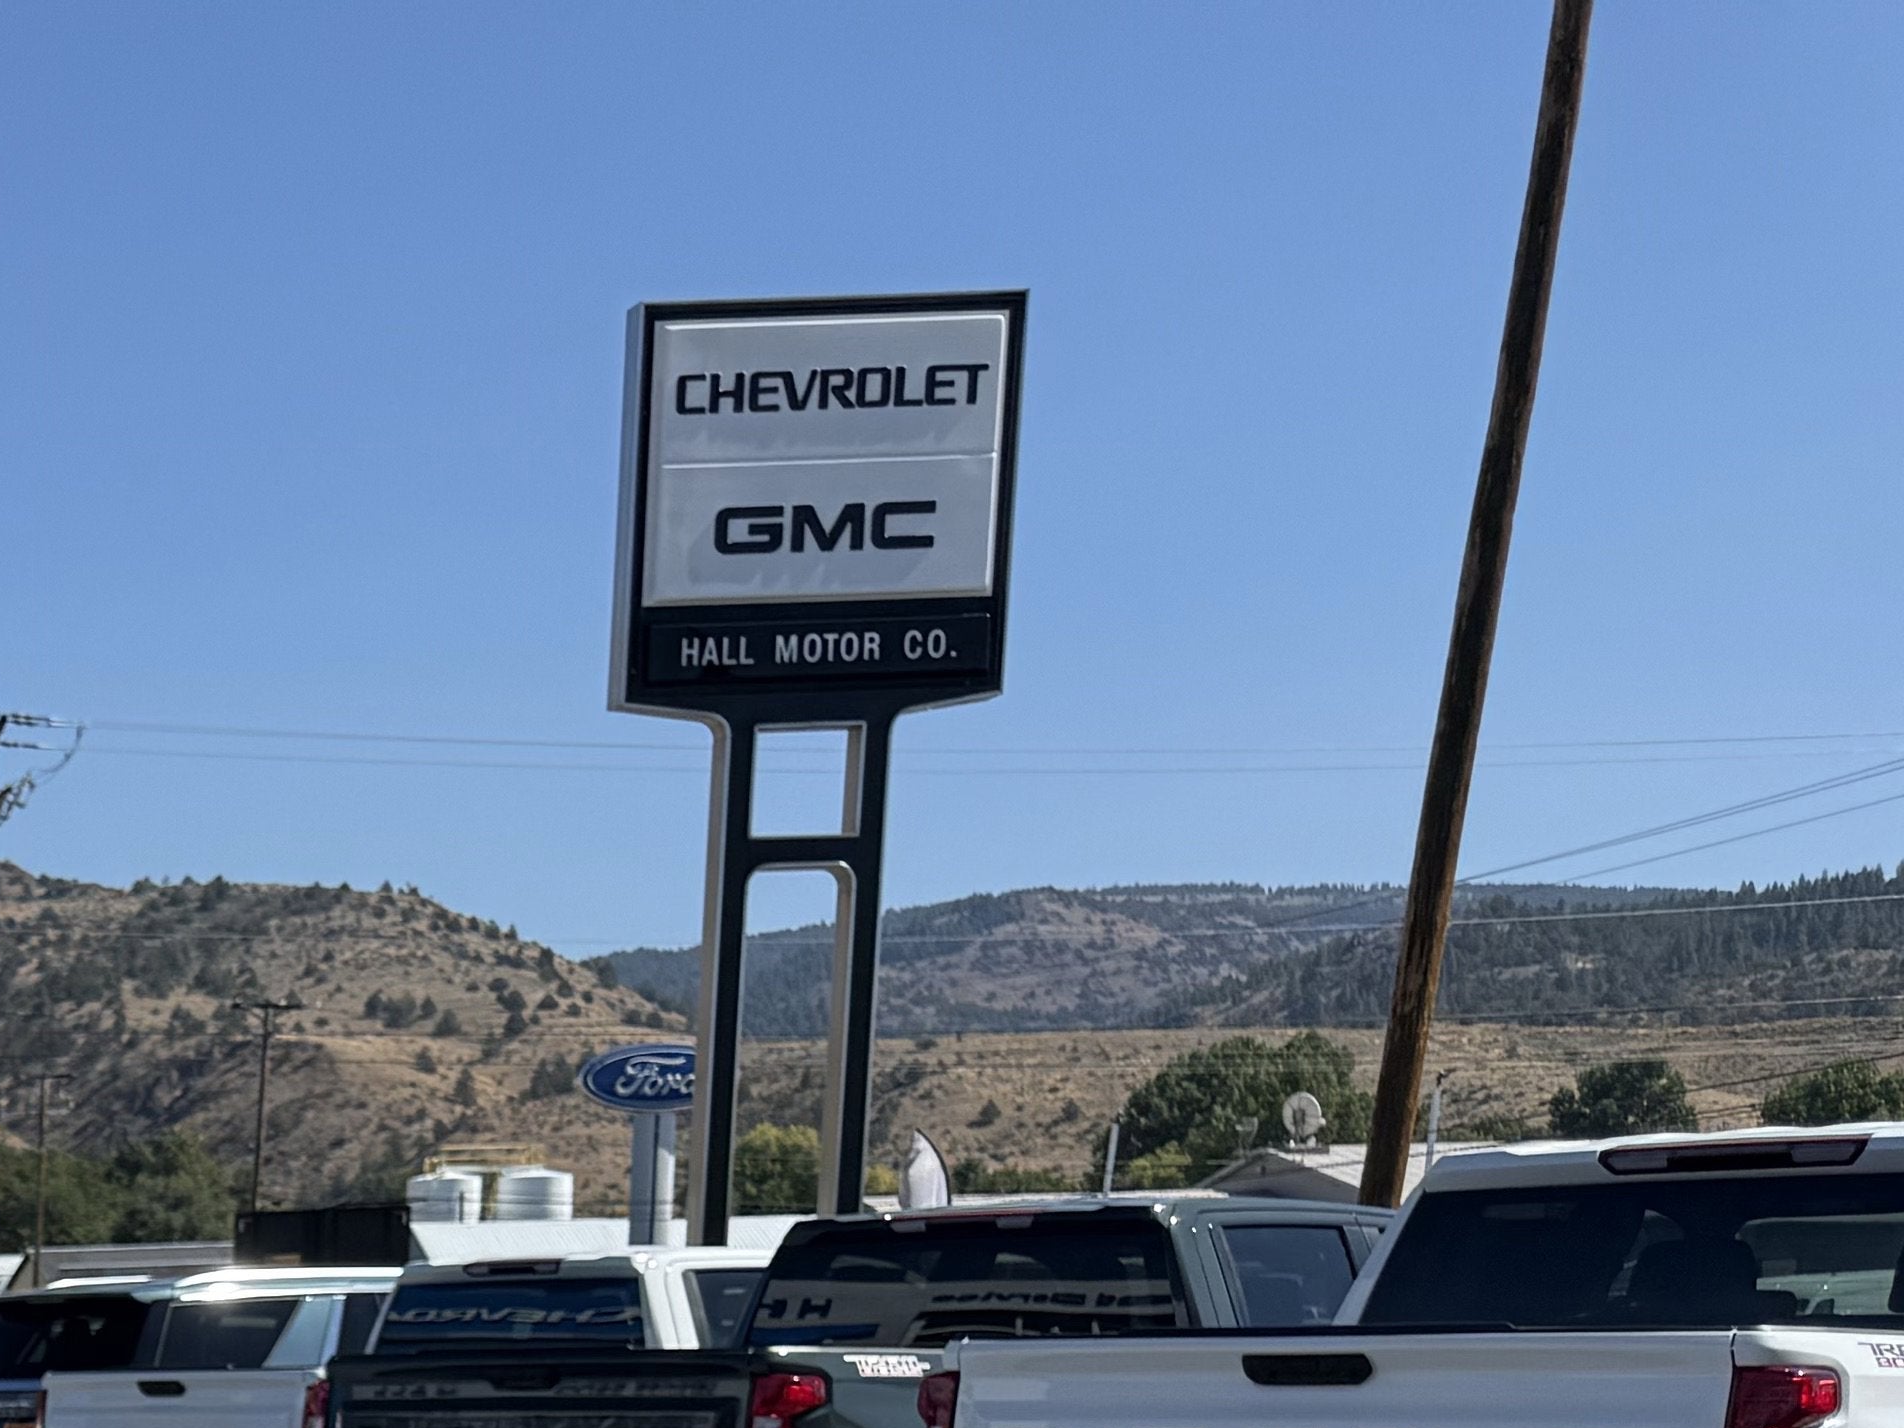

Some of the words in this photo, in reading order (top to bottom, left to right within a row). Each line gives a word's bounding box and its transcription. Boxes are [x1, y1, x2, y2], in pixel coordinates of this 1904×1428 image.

[674, 362, 990, 416] CHEVROLET
[713, 499, 938, 556] GMC
[680, 635, 755, 668] HALL
[774, 630, 881, 665] MOTOR
[902, 628, 959, 661] CO.
